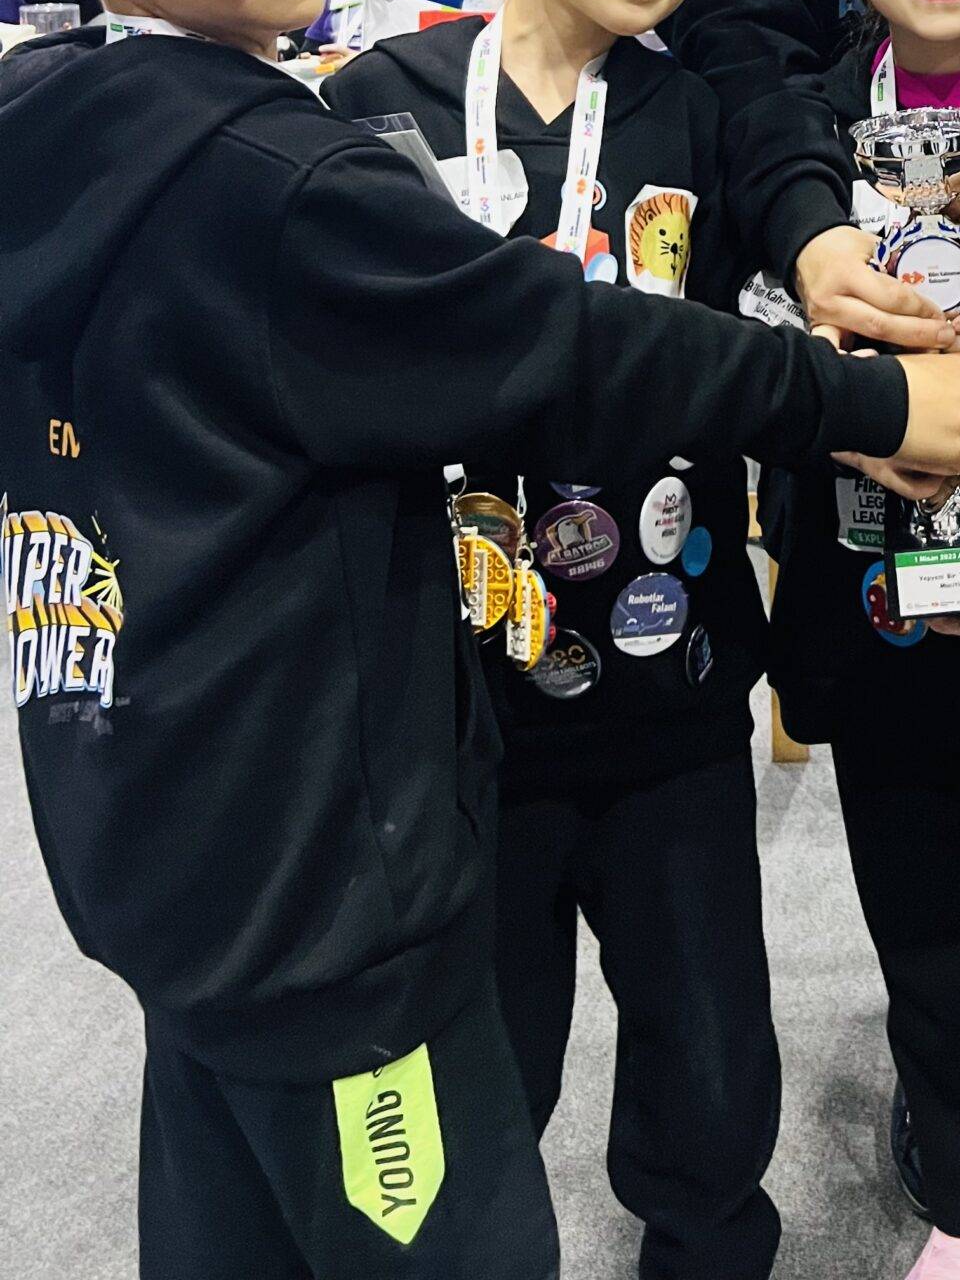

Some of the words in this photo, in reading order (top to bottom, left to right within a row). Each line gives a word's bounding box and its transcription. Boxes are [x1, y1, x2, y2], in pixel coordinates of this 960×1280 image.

[852, 509, 886, 525] LEAG
[858, 494, 884, 510] LEG
[859, 531, 885, 545] EXPL
[2, 516, 93, 614] UPER
[10, 620, 115, 707] OWER
[366, 1088, 417, 1218] YOUNG
